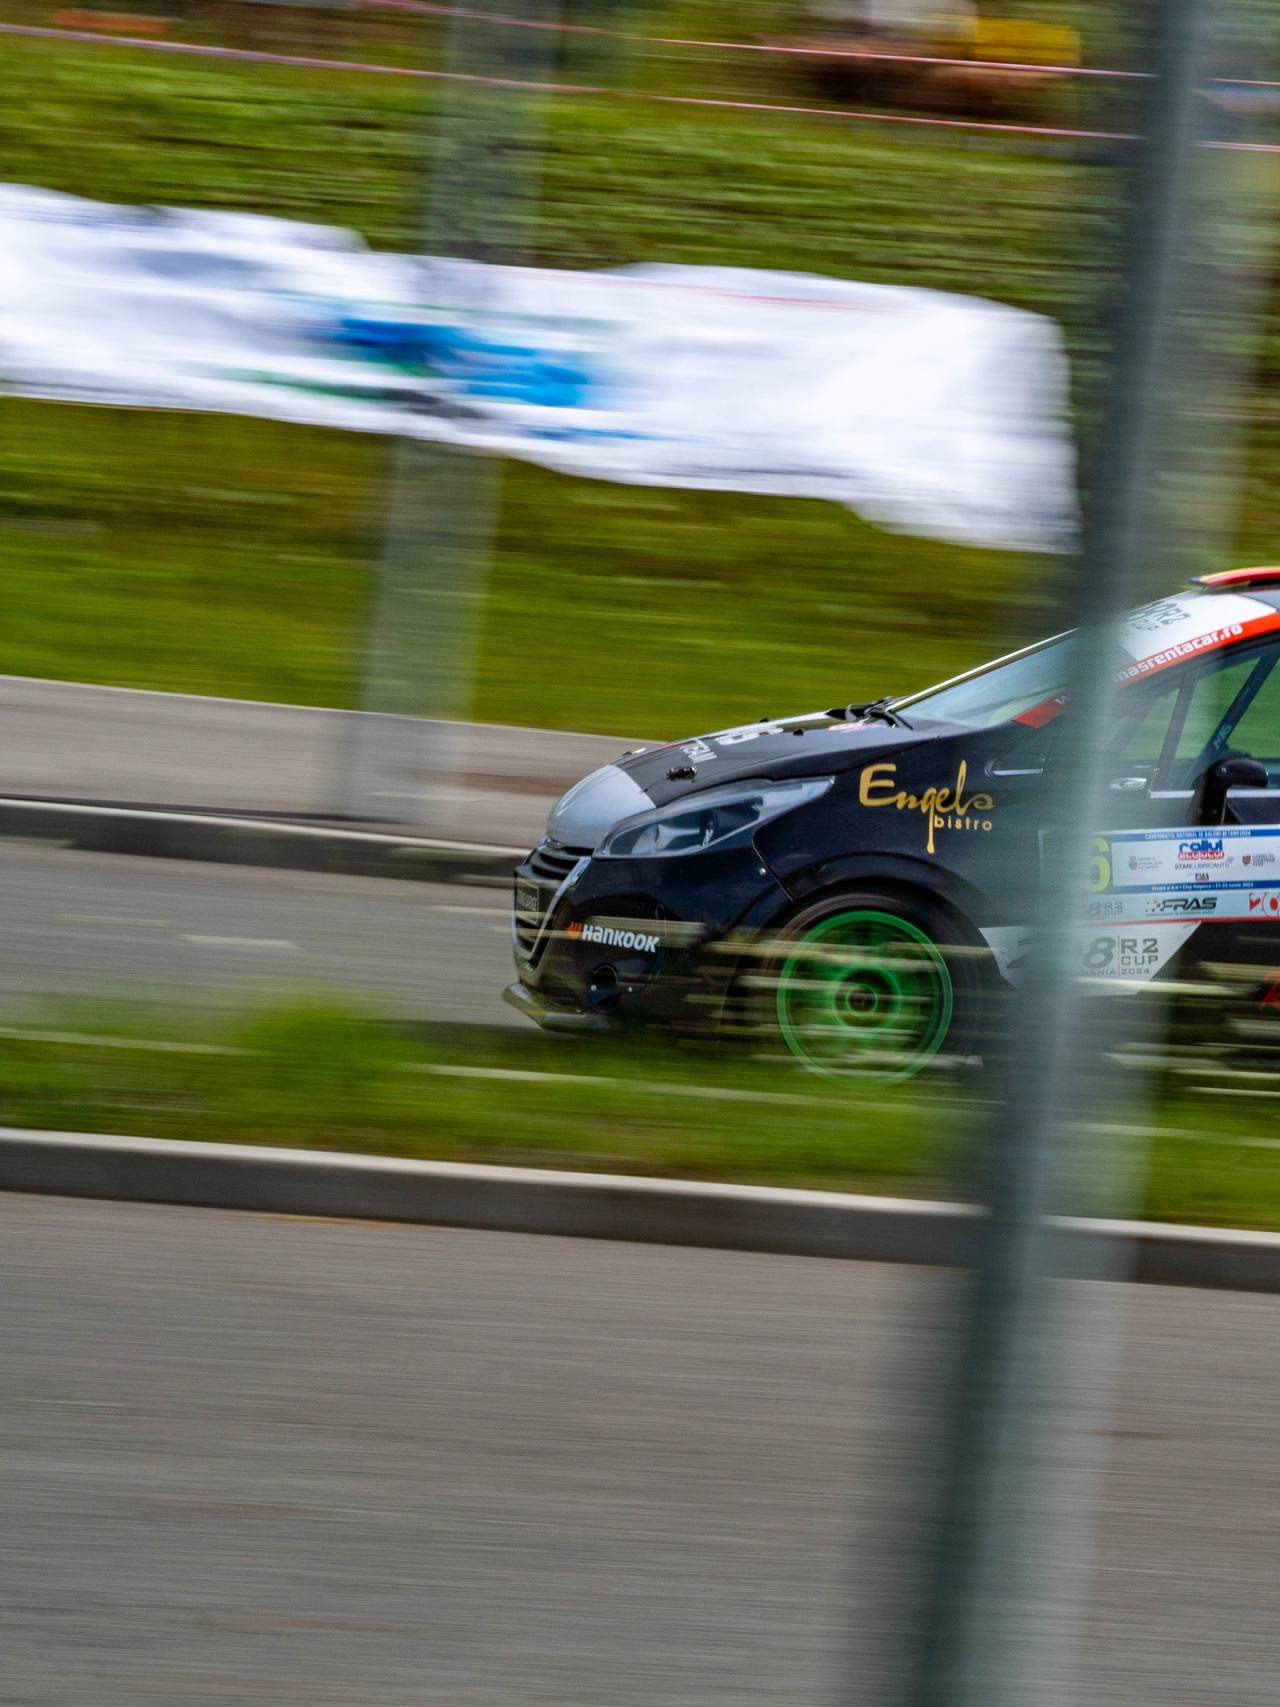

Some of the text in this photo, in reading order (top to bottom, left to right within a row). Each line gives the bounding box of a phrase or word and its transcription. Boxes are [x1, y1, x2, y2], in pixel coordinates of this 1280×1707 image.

[859, 760, 995, 854] Engels
[933, 814, 992, 831] bistro
[1161, 897, 1218, 911] FRAS
[1120, 938, 1158, 954] R2
[1121, 956, 1158, 966] CUP
